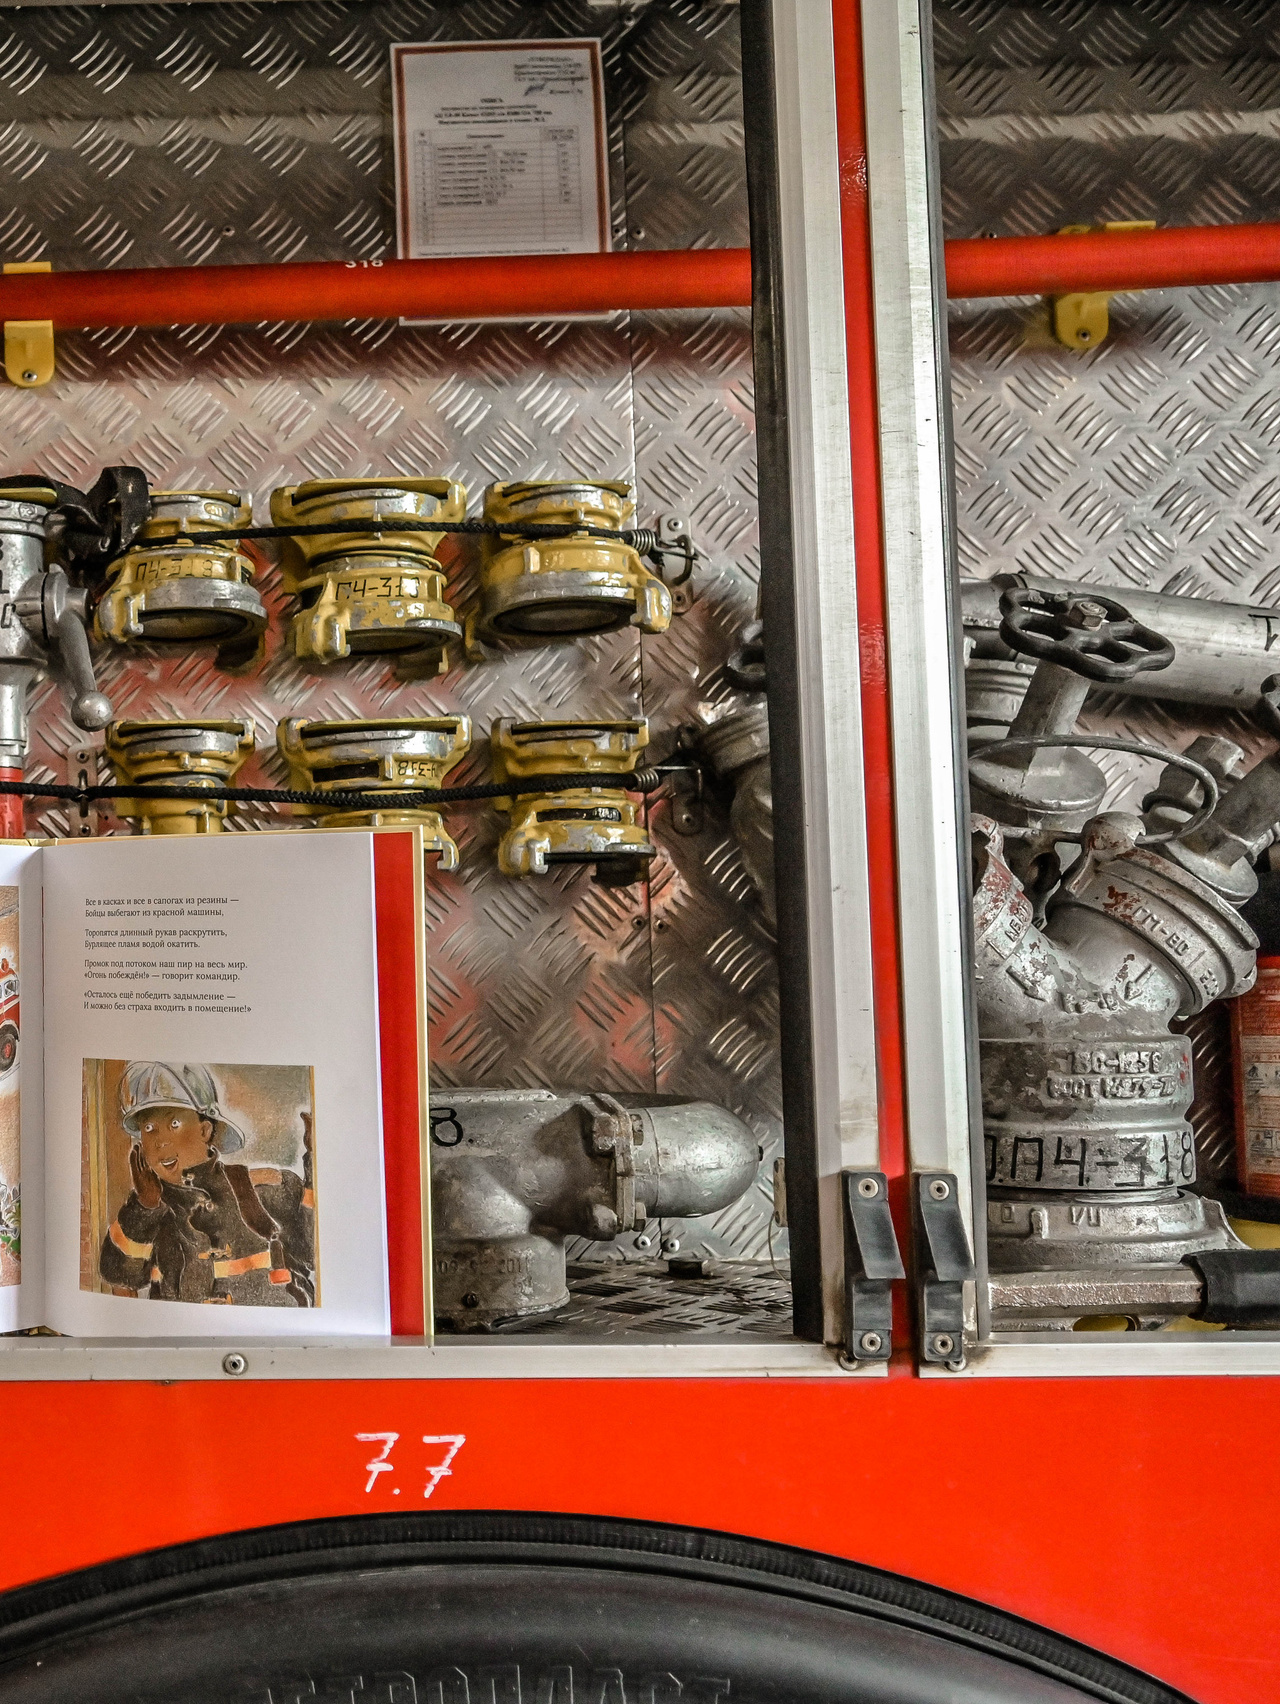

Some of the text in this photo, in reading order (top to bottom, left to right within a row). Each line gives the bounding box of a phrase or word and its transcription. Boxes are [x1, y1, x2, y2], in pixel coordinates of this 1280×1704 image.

[85, 898, 96, 906] Все
[196, 897, 228, 906] резины
[85, 909, 106, 918] Бойцы
[107, 909, 141, 917] выбегают
[152, 908, 185, 918] красной
[186, 908, 224, 917] машины,
[85, 928, 228, 938] Торопятся длинный рукав раскрутить,
[84, 940, 117, 949] Бурлящее
[142, 940, 165, 948] водой
[84, 959, 110, 968] Промок
[110, 960, 124, 969] под
[177, 961, 193, 969] пир
[227, 962, 248, 970] мир.
[84, 971, 107, 979] «Огонь
[108, 971, 150, 980] побеждён!»
[162, 972, 194, 981] говорит
[195, 973, 240, 982] командир.
[83, 990, 118, 999] «Осталось
[119, 991, 134, 1000] ещё
[135, 991, 172, 1000] победить
[173, 992, 224, 1001] задымление
[90, 1002, 113, 1010] можно
[114, 1002, 126, 1011] без
[127, 1003, 152, 1012] страха
[154, 1003, 186, 1013] входить
[194, 1004, 252, 1014] помещение!»
